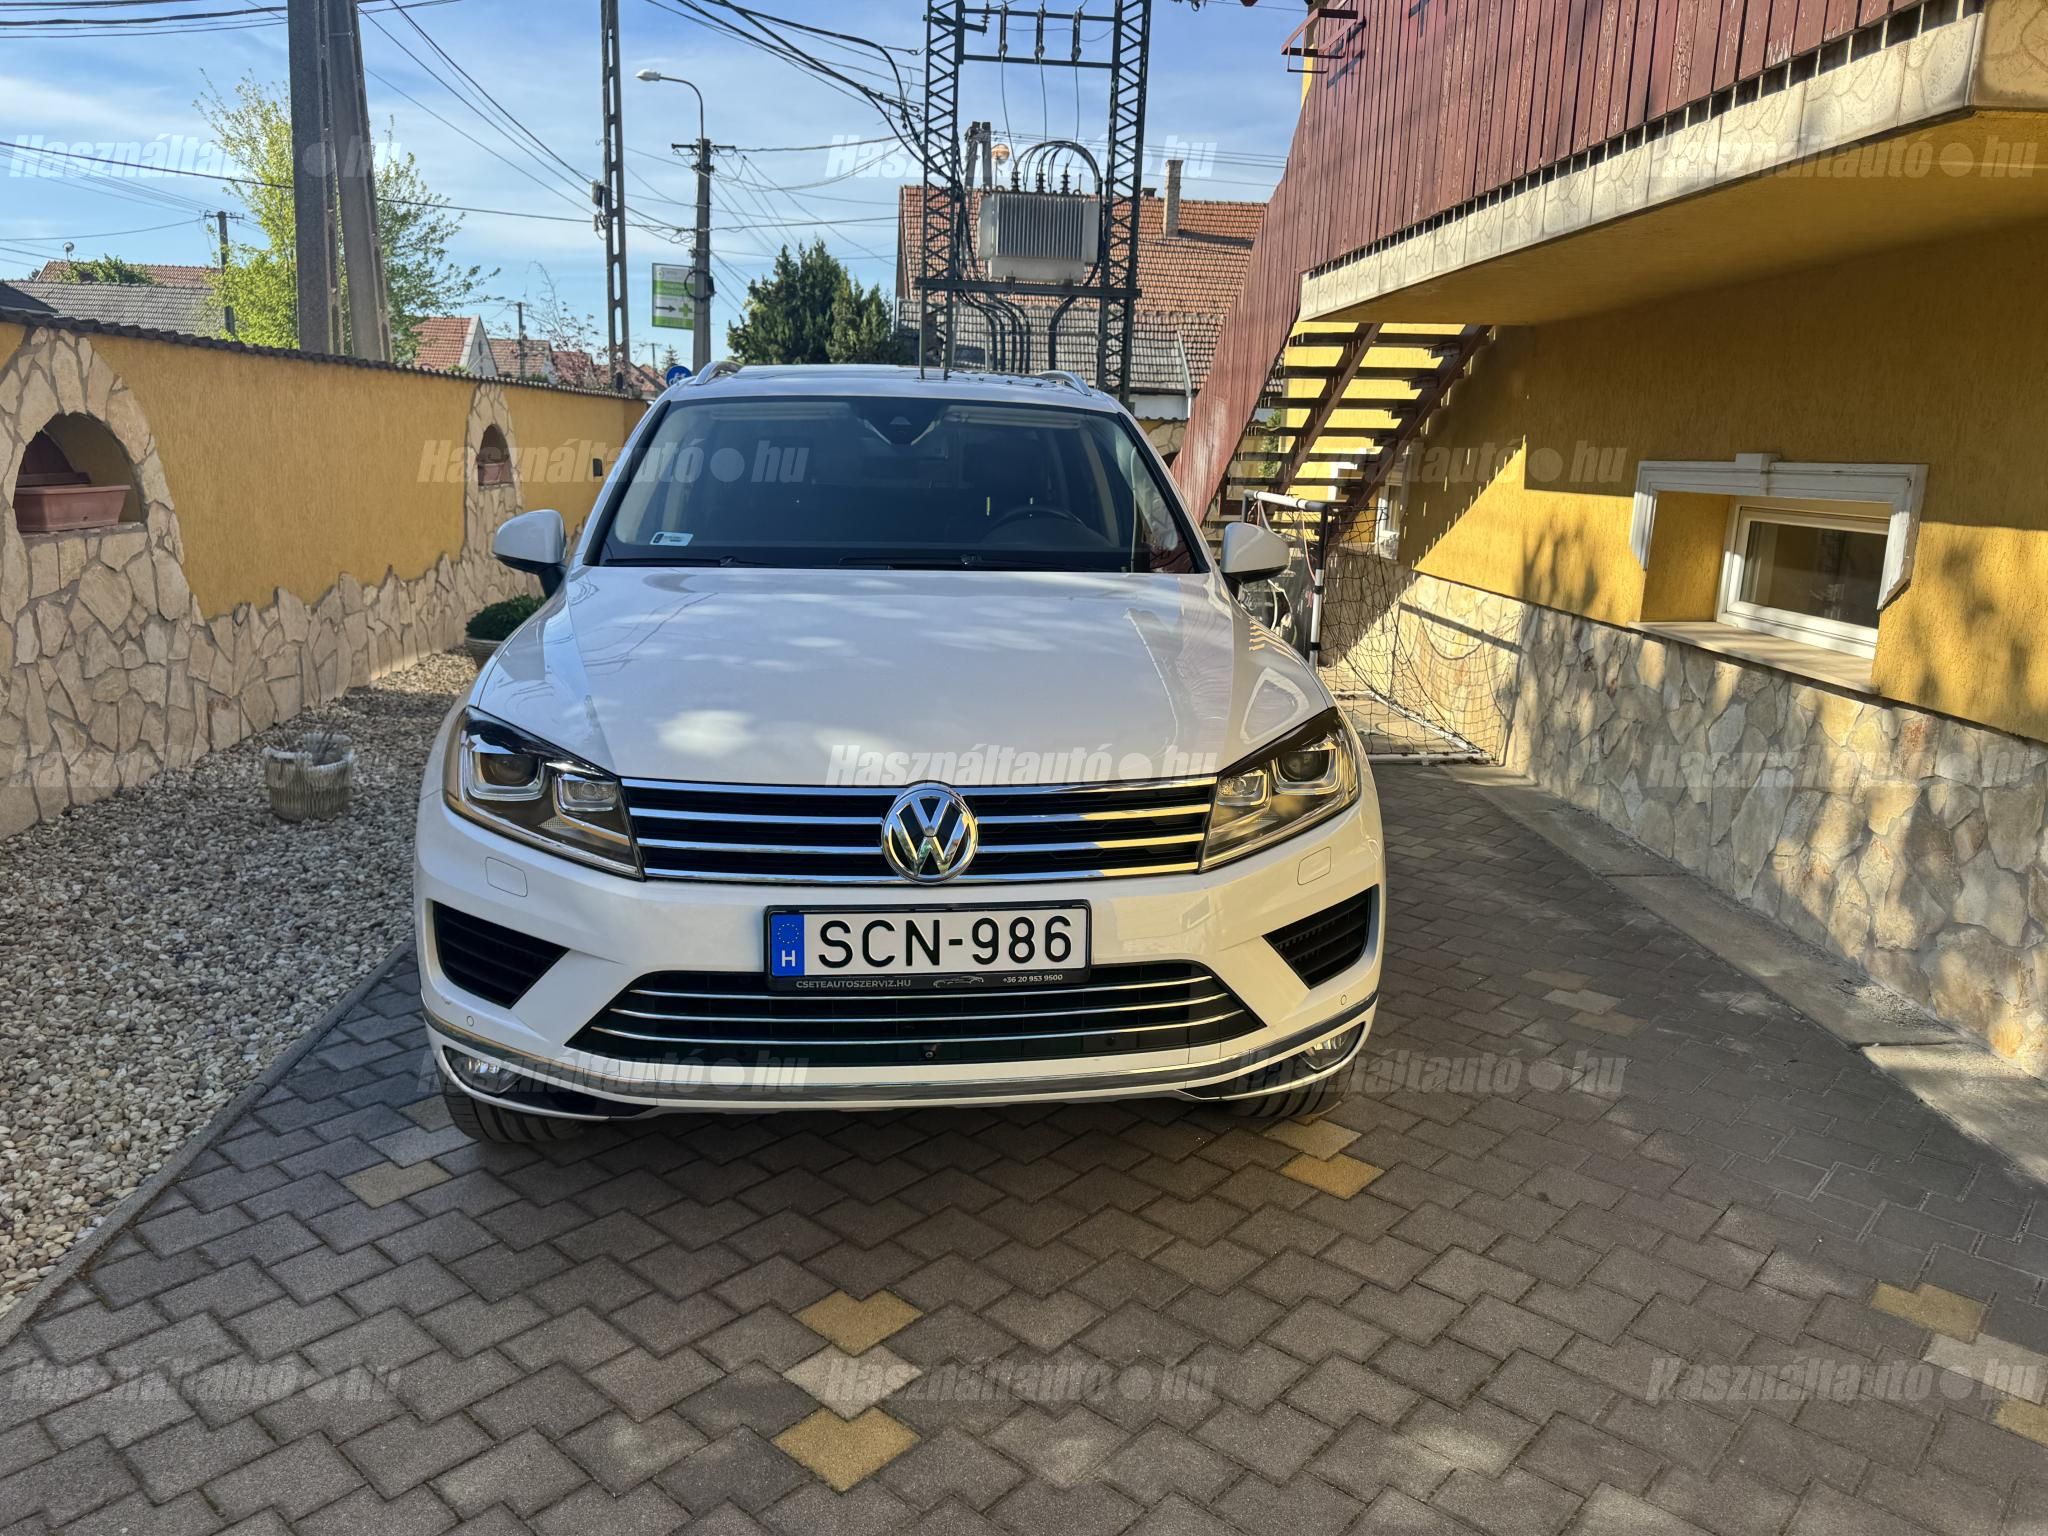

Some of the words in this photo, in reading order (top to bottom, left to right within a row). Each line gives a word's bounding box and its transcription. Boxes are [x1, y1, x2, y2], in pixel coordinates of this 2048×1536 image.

[817, 914, 1073, 969] SCN-986
[781, 949, 797, 968] H
[796, 979, 912, 989] CSETEAUTOSZERVIZ.HU
